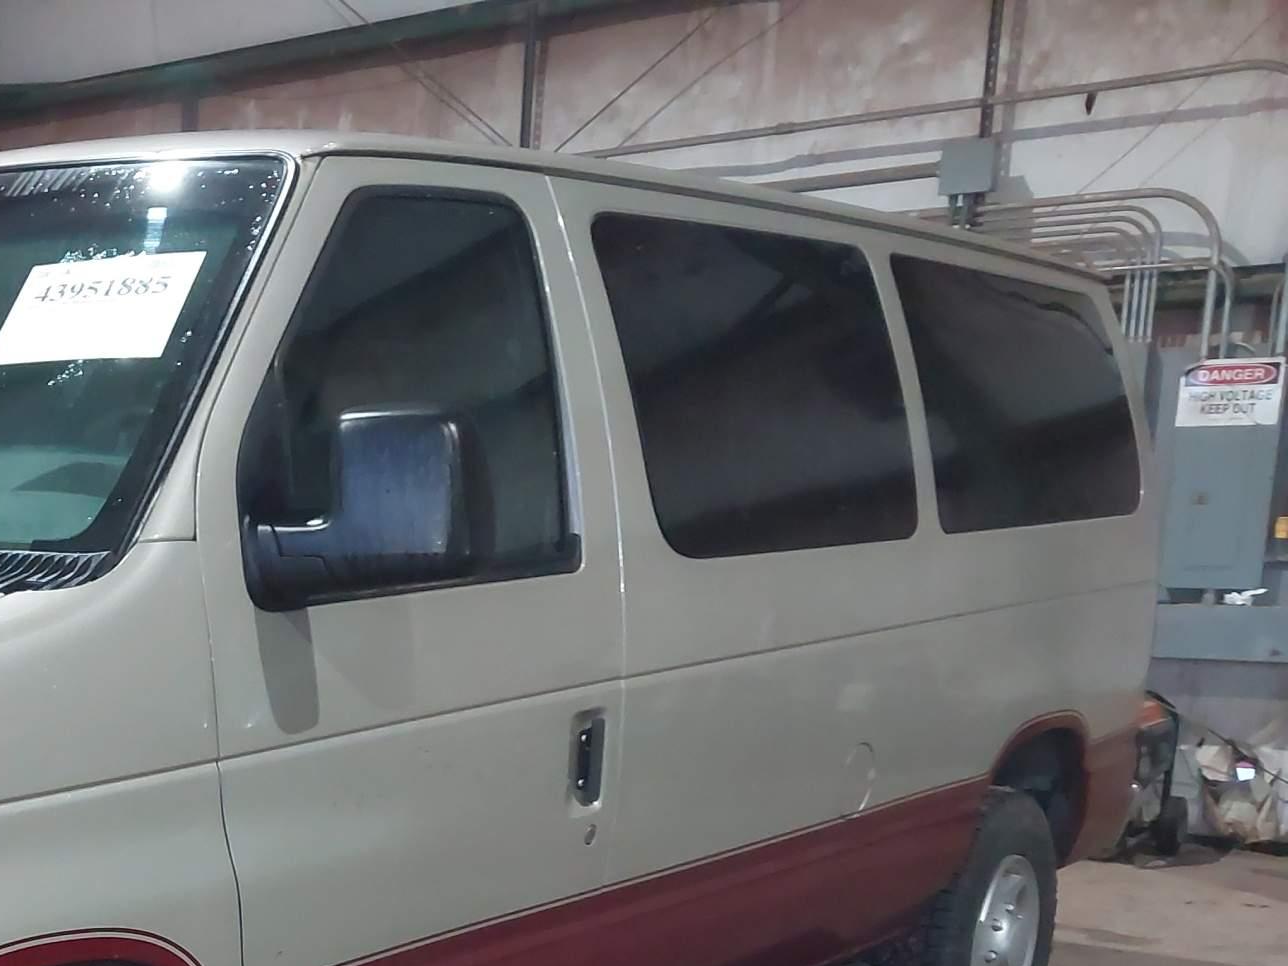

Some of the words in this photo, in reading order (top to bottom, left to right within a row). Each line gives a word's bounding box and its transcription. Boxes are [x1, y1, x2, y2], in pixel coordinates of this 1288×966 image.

[34, 275, 172, 302] 43951885
[1197, 368, 1265, 381] DANGER
[1219, 390, 1273, 401] VOLTAGE
[1200, 403, 1230, 415] KEEP
[1232, 402, 1257, 414] OUT
